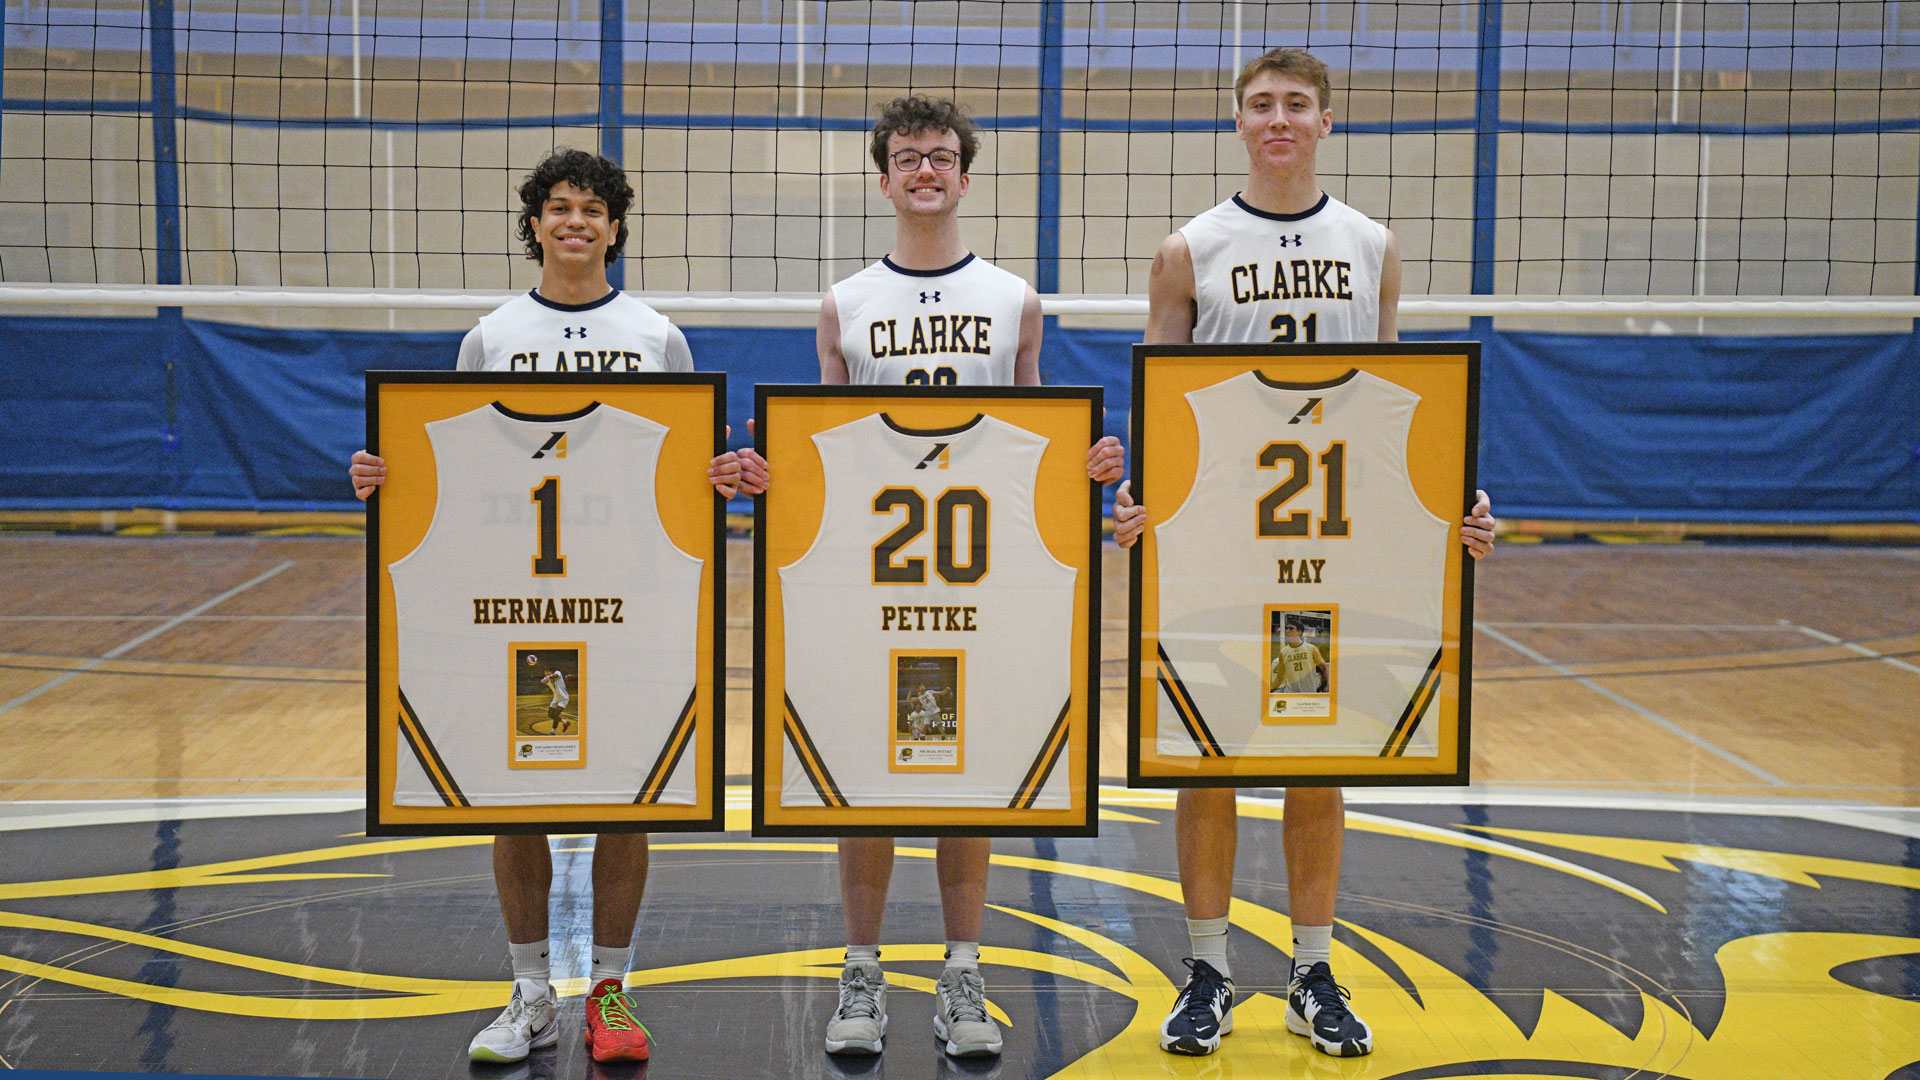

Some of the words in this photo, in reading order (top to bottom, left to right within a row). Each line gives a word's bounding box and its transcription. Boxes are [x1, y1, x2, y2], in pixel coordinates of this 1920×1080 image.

[1231, 259, 1353, 305] CLARKE
[870, 314, 992, 359] CLARKE
[1255, 440, 1351, 539] 21
[530, 475, 567, 577] 1
[871, 485, 991, 586] 20
[1277, 559, 1326, 584] MAY
[473, 598, 624, 624] HERNANDEZ
[882, 606, 977, 632] PETTKE
[1294, 662, 1303, 671] 21
